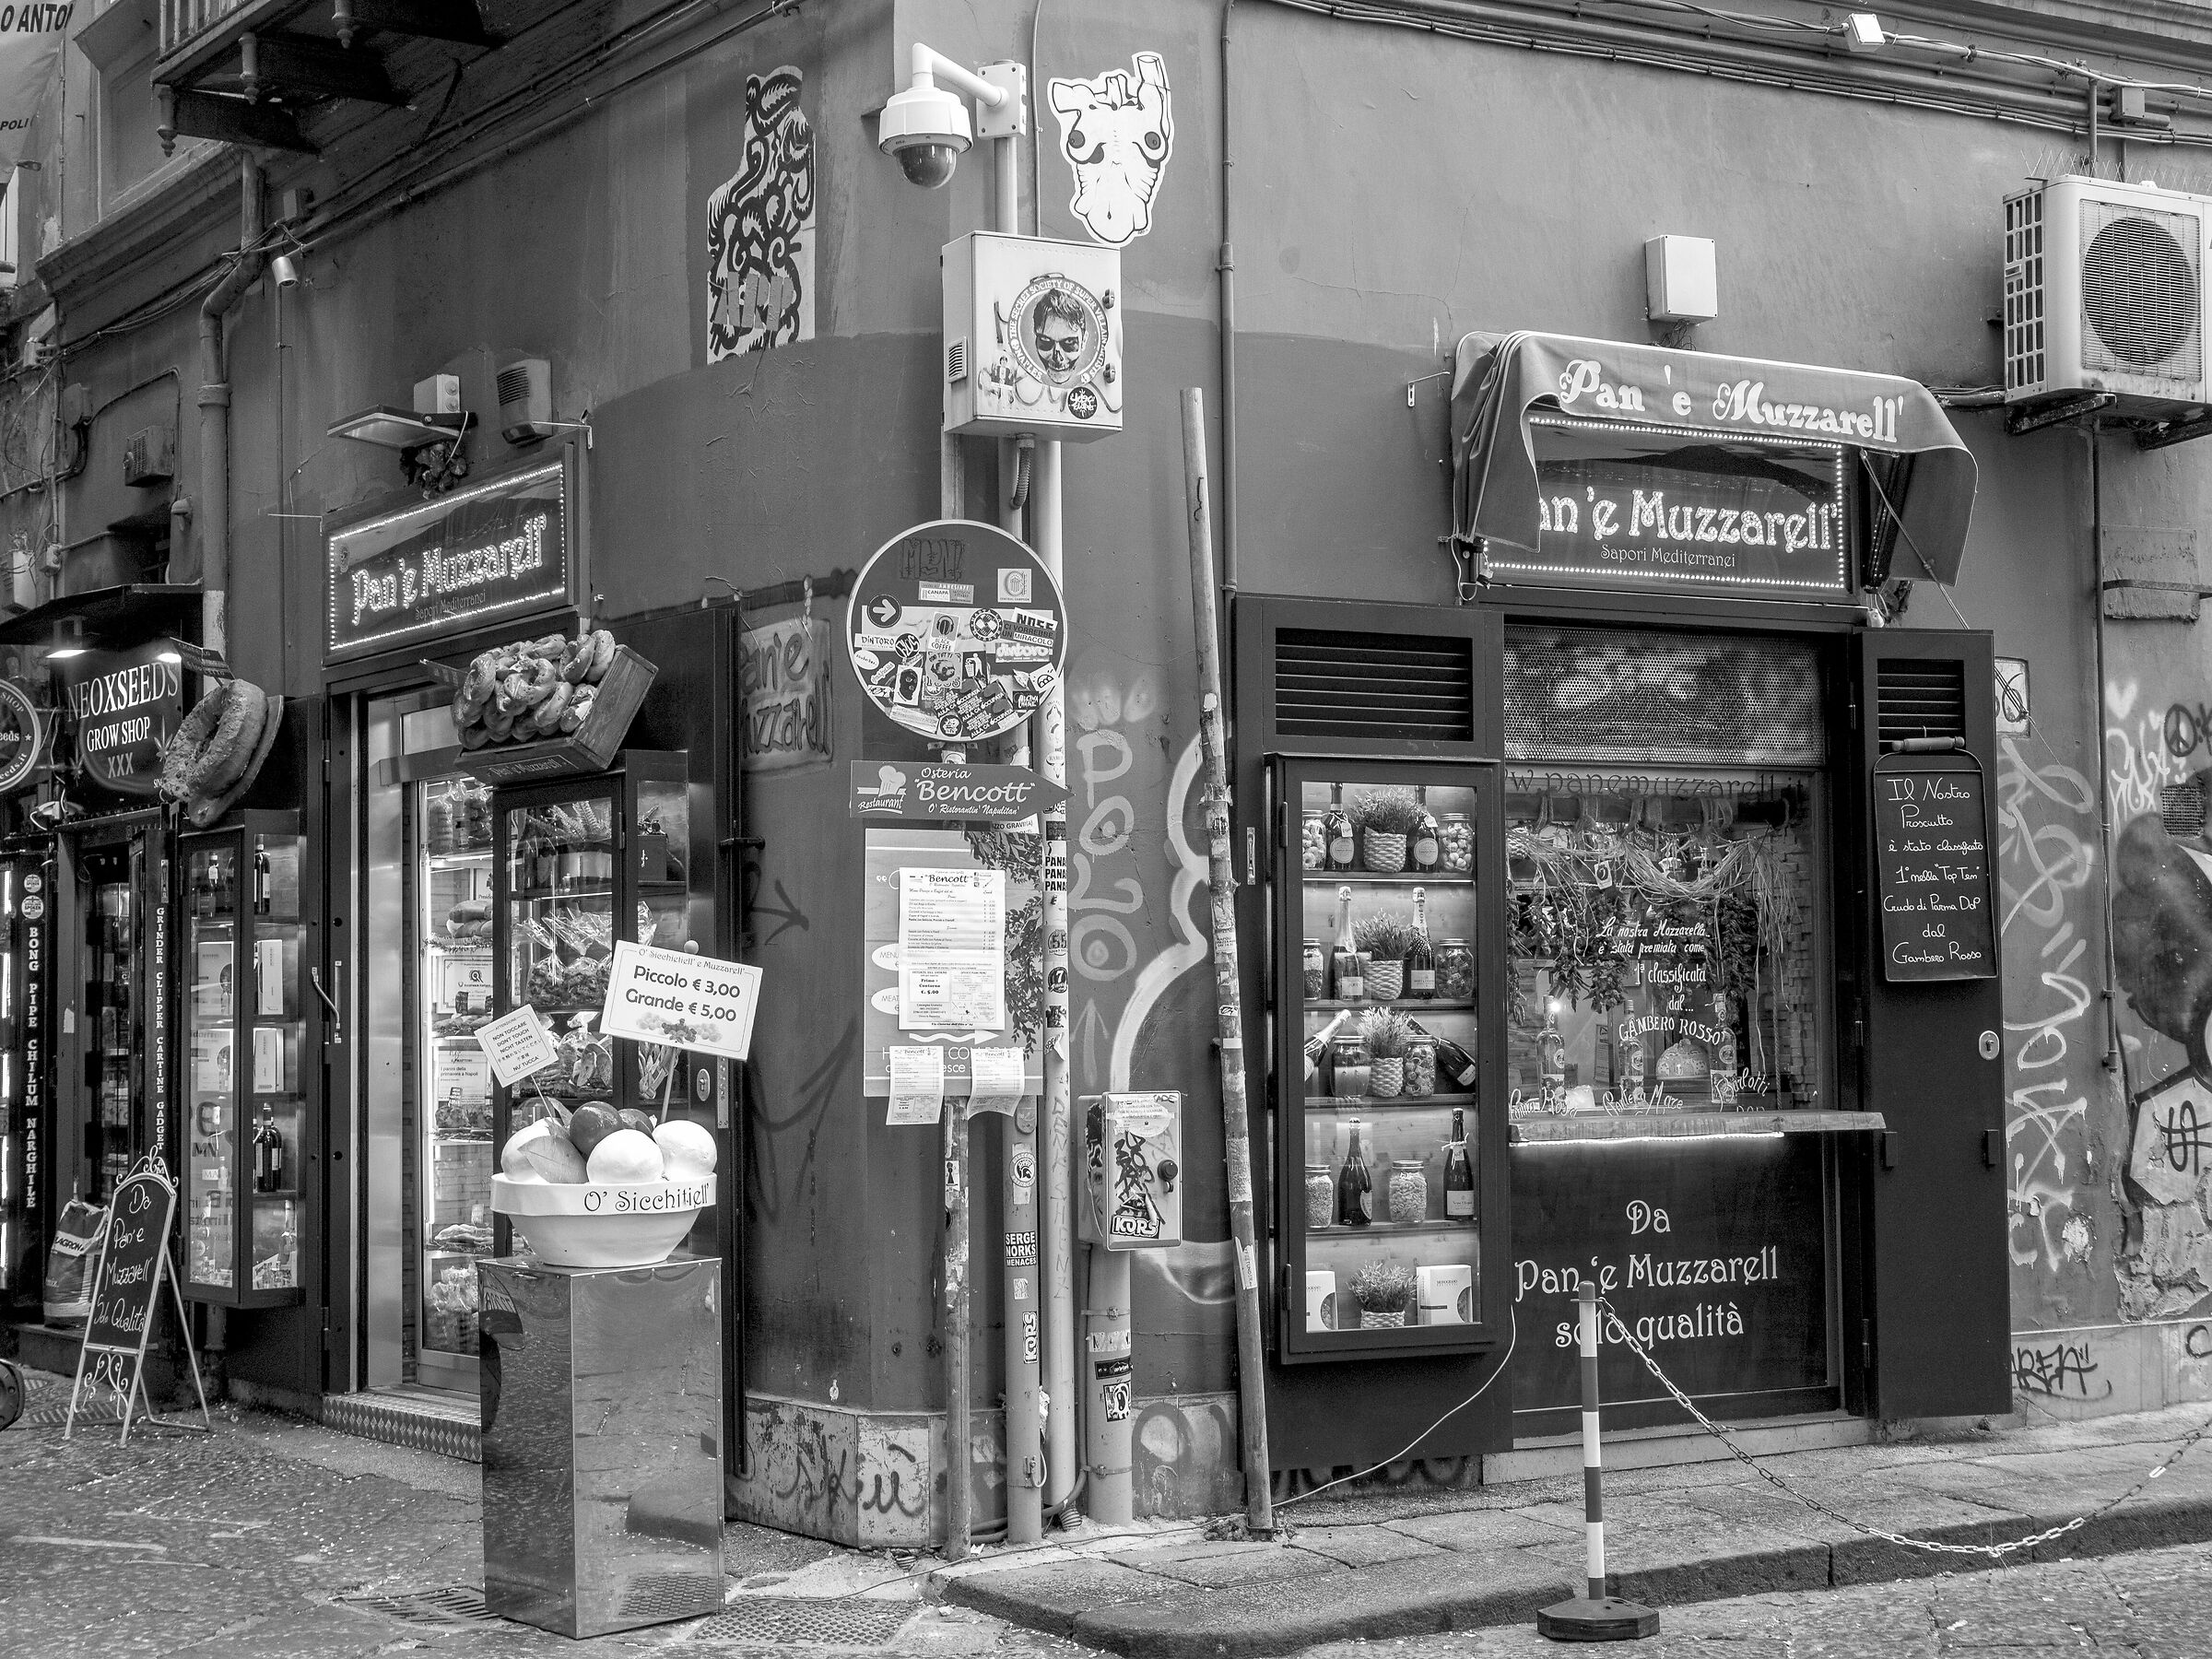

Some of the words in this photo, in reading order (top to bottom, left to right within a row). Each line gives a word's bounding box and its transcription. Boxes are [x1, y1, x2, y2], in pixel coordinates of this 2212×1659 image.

[1011, 291, 1033, 321] SECRET
[1030, 279, 1062, 295] SOCIETY
[1063, 281, 1074, 290] OF
[1076, 287, 1098, 311] SUPER
[1015, 347, 1042, 382] NAPLES
[1559, 359, 1645, 411] Pan
[1712, 380, 1903, 443] Muzzarell'
[1539, 496, 1578, 533] an
[1600, 545, 1647, 563] Sapori
[1651, 547, 1735, 569] Mediterranei
[1014, 633, 1053, 645] MIRACOLO
[1, 692, 24, 712] SHOP
[67, 662, 179, 722] NEOXSEEDS
[87, 723, 120, 752] GROW
[121, 716, 150, 745] SHOP
[108, 752, 134, 779] XXX
[922, 767, 971, 779] Osteria
[857, 794, 904, 809] Restaurant
[1887, 778, 1914, 801] Il
[1923, 777, 1971, 801] Nostro
[1900, 804, 1953, 829] Prosciutto
[1888, 839, 1898, 852] è
[1903, 840, 1932, 852] stato
[1911, 870, 1939, 882] nella
[1883, 895, 1915, 912] Crudo
[1917, 898, 1927, 911] di
[1930, 893, 1958, 911] Parma
[156, 907, 165, 964] GRINDER
[1595, 916, 1616, 937] La
[1618, 921, 1648, 937] nostra
[1922, 924, 1946, 938] dal
[29, 926, 39, 971] BONG
[1610, 940, 1633, 954] stata
[1638, 939, 1677, 959] premiata
[1685, 944, 1704, 953] come
[1892, 941, 1945, 964] Gambero
[1948, 940, 1982, 960] Rosso
[633, 965, 688, 988] Piccolo
[692, 979, 701, 991] €
[704, 981, 740, 998] 3,00
[1648, 961, 1706, 993] classificata
[29, 983, 38, 1029] PIPE
[156, 971, 164, 1029] CLIPPER
[626, 988, 684, 1011] Grande
[688, 1002, 698, 1015] €
[700, 1004, 736, 1021] 5,00
[492, 1033, 504, 1041] NON
[504, 1020, 527, 1034] TOCCARE
[512, 1029, 530, 1039] TOUCH
[1618, 1016, 1675, 1041] GAMBERO
[500, 1043, 514, 1053] NICHT
[515, 1034, 533, 1045] TASTEN
[26, 1040, 38, 1106] CHILUM
[156, 1037, 165, 1094] CARTINE
[156, 1101, 165, 1150] GADGET
[26, 1117, 38, 1208] NARGHILE
[129, 1184, 152, 1214] Da
[583, 1190, 607, 1213] O'
[1113, 1216, 1159, 1238] KORS
[1626, 1199, 1671, 1235] Da
[1006, 1232, 1036, 1244] SERGE
[1006, 1244, 1036, 1257] NORKS
[1006, 1257, 1037, 1266] MENACES
[1514, 1260, 1580, 1302] Pan
[1627, 1245, 1778, 1289] Muzzarell
[1023, 1312, 1037, 1363] KORS
[1636, 1301, 1744, 1350] qualità
